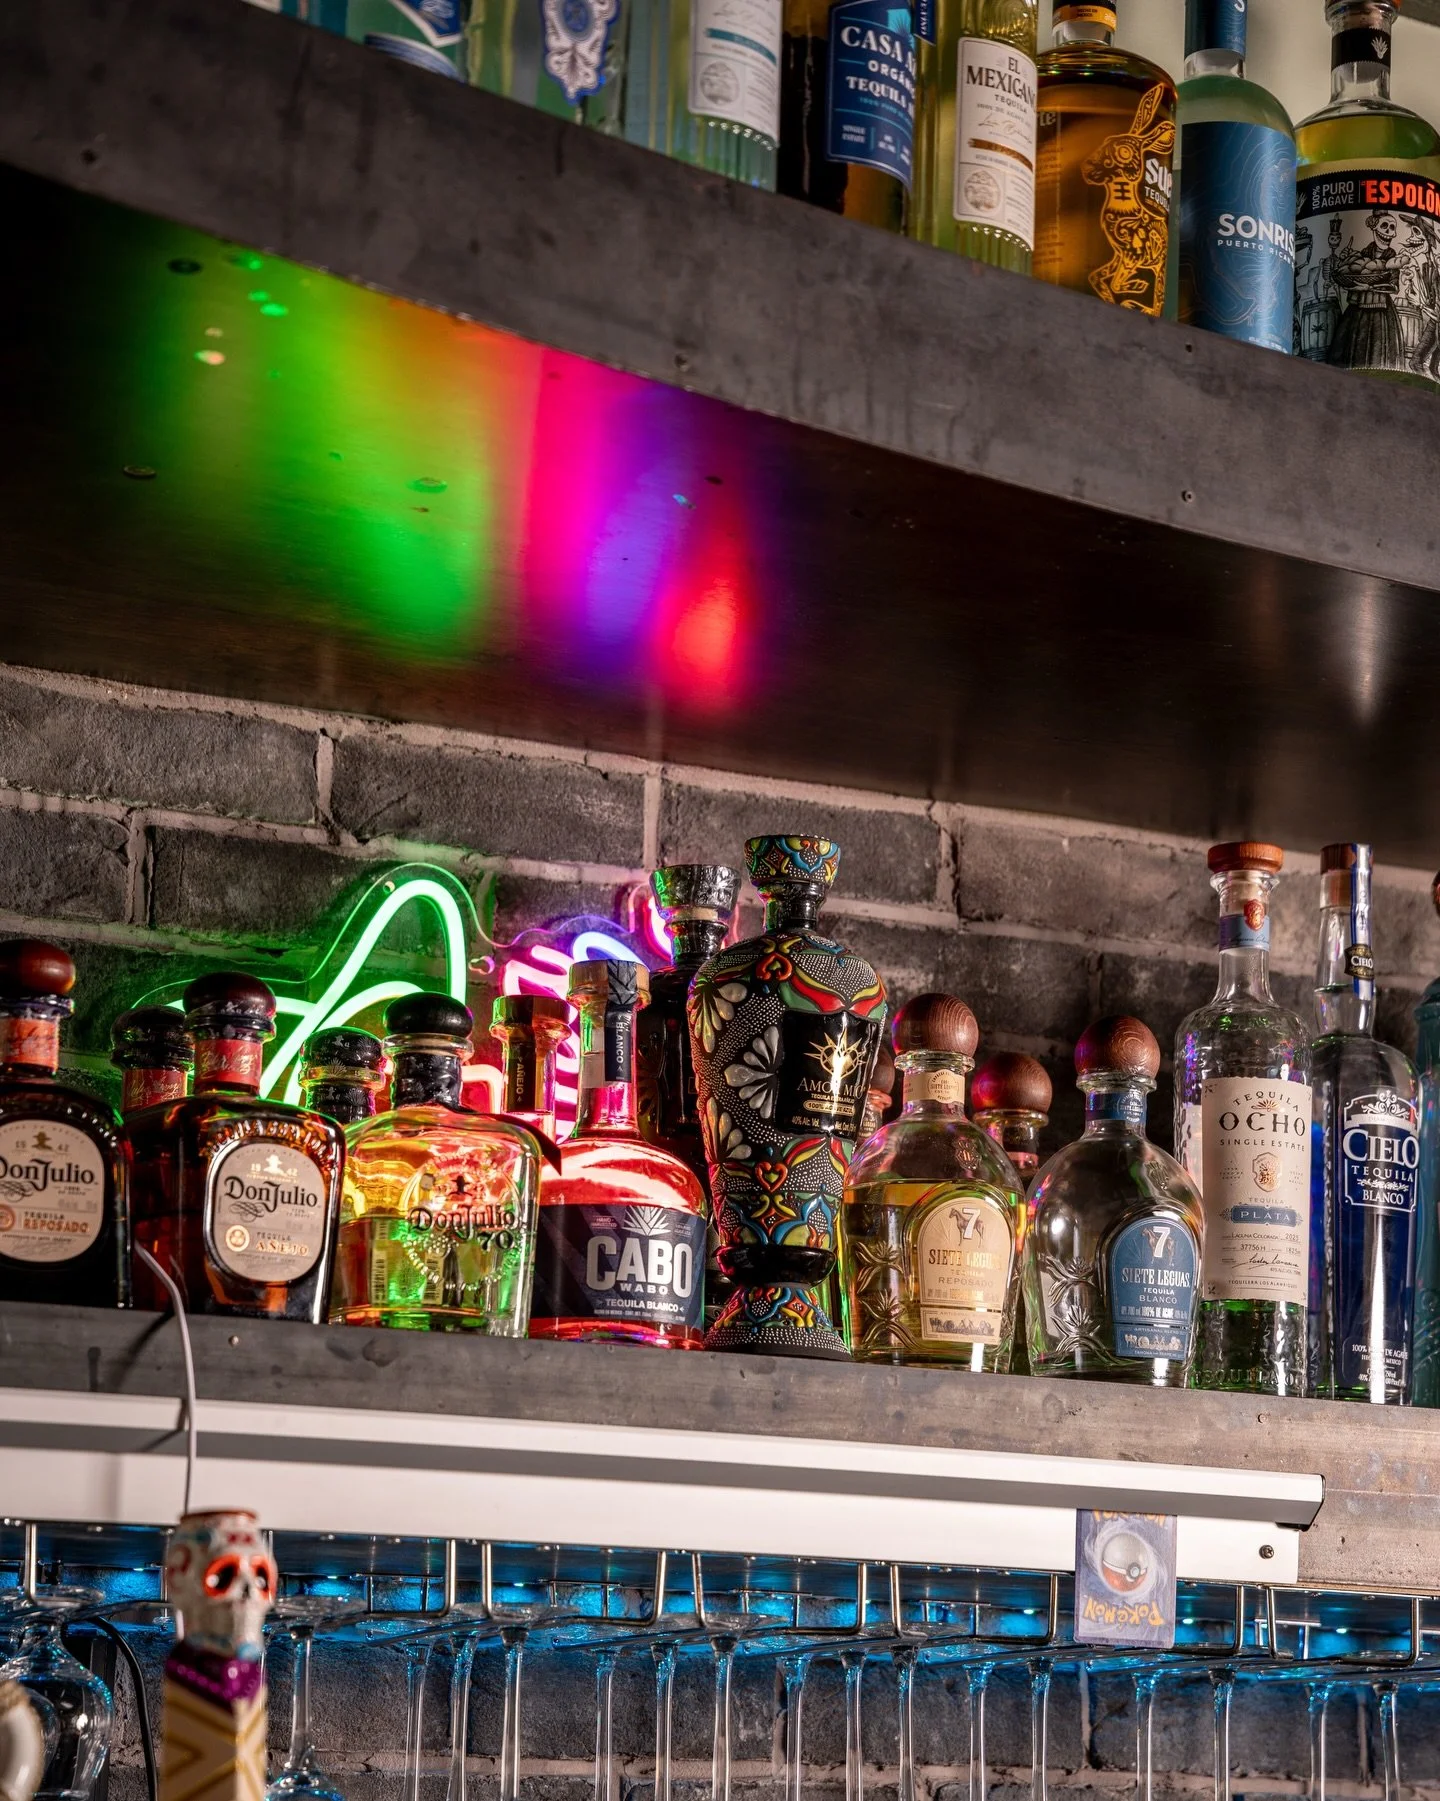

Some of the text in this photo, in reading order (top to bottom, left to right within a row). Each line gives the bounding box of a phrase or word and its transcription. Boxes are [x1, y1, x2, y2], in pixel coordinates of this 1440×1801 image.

[841, 25, 904, 63] CASA
[1008, 56, 1021, 75] EL
[845, 75, 907, 109] TEQUILA
[994, 94, 1028, 114] TEQUILA
[1312, 185, 1321, 210] 100%
[1322, 181, 1354, 197] PURO
[1321, 194, 1354, 208] AGAVE
[1217, 239, 1292, 265] PUERTO RICAN
[1351, 955, 1374, 969] CIELO
[615, 1021, 627, 1064] BLANCO
[516, 1063, 527, 1095] AÑEJO
[808, 1102, 823, 1110] 100%
[1233, 1090, 1300, 1113] TEQUILA
[1219, 1112, 1306, 1137] OCHO
[1271, 1140, 1305, 1152] ESTATE
[1343, 1128, 1420, 1170] CIELO
[1352, 1164, 1414, 1183] TEQUILA
[1362, 1189, 1404, 1205] BLANCO
[24, 1211, 65, 1220] TEQUILA
[962, 1207, 981, 1240] 7
[1241, 1211, 1291, 1221] PLATA
[23, 1218, 90, 1233] REPOSADO
[256, 1231, 292, 1241] TEQUILA
[477, 1229, 516, 1250] 70
[1152, 1225, 1171, 1258] 7
[256, 1239, 310, 1256] AÑEJO
[586, 1235, 693, 1298] CABO
[928, 1248, 962, 1267] SIETE
[938, 1277, 994, 1288] REPOSADO
[1122, 1267, 1190, 1288] SIETE LEGUAS
[620, 1283, 669, 1296] WABO
[1143, 1286, 1175, 1296] TEQUILA
[606, 1298, 679, 1313] TEQUILA BLANCO
[1139, 1294, 1178, 1305] BLANCO
[1352, 1344, 1367, 1353] 100%
